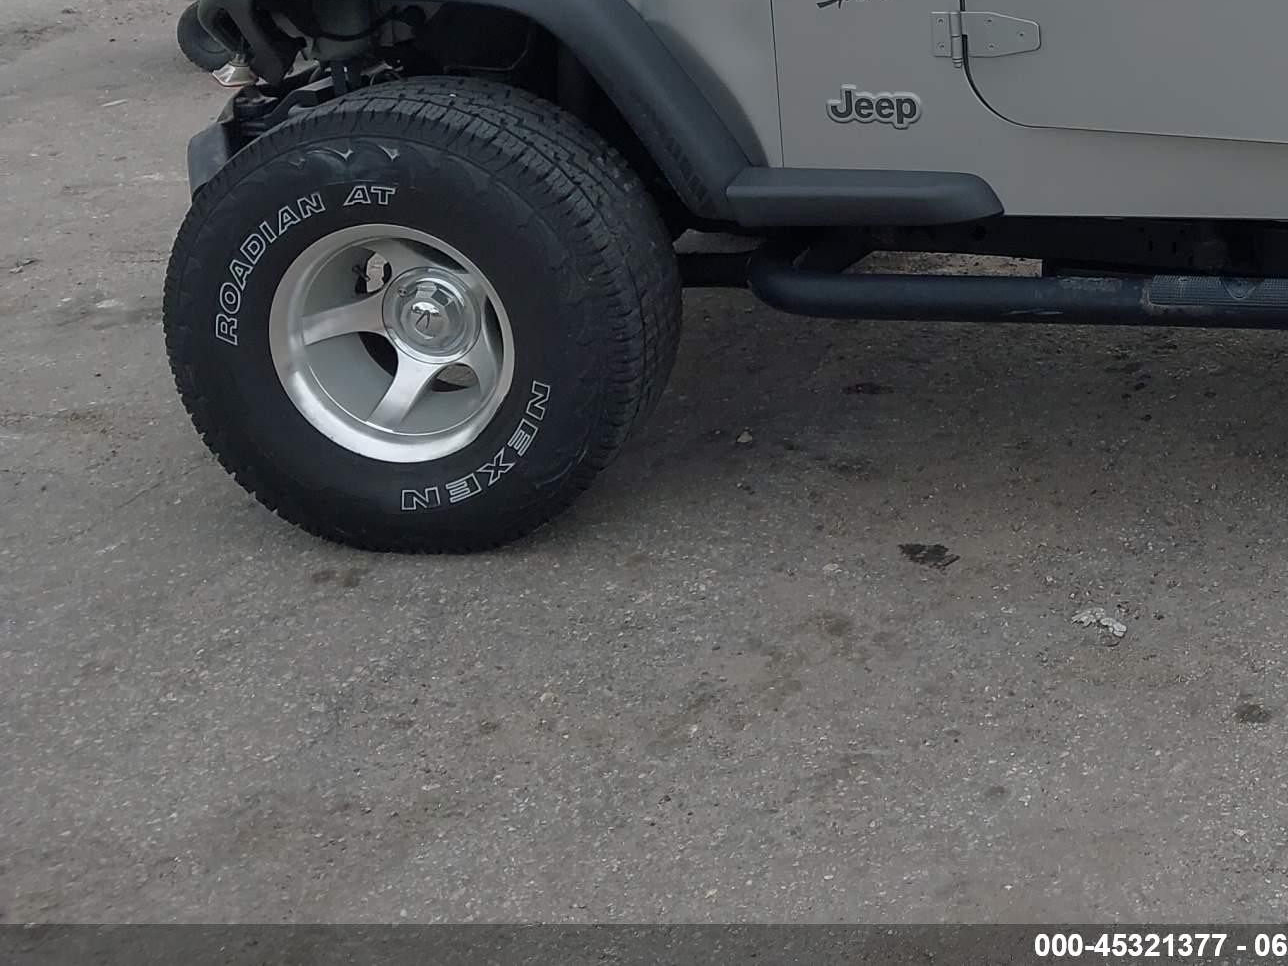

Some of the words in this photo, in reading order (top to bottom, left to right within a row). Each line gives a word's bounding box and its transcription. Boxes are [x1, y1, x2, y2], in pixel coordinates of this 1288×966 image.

[830, 89, 917, 125] Jeep
[215, 192, 326, 346] ROADIAN
[343, 185, 397, 207] AT
[401, 381, 551, 511] NEXEN
